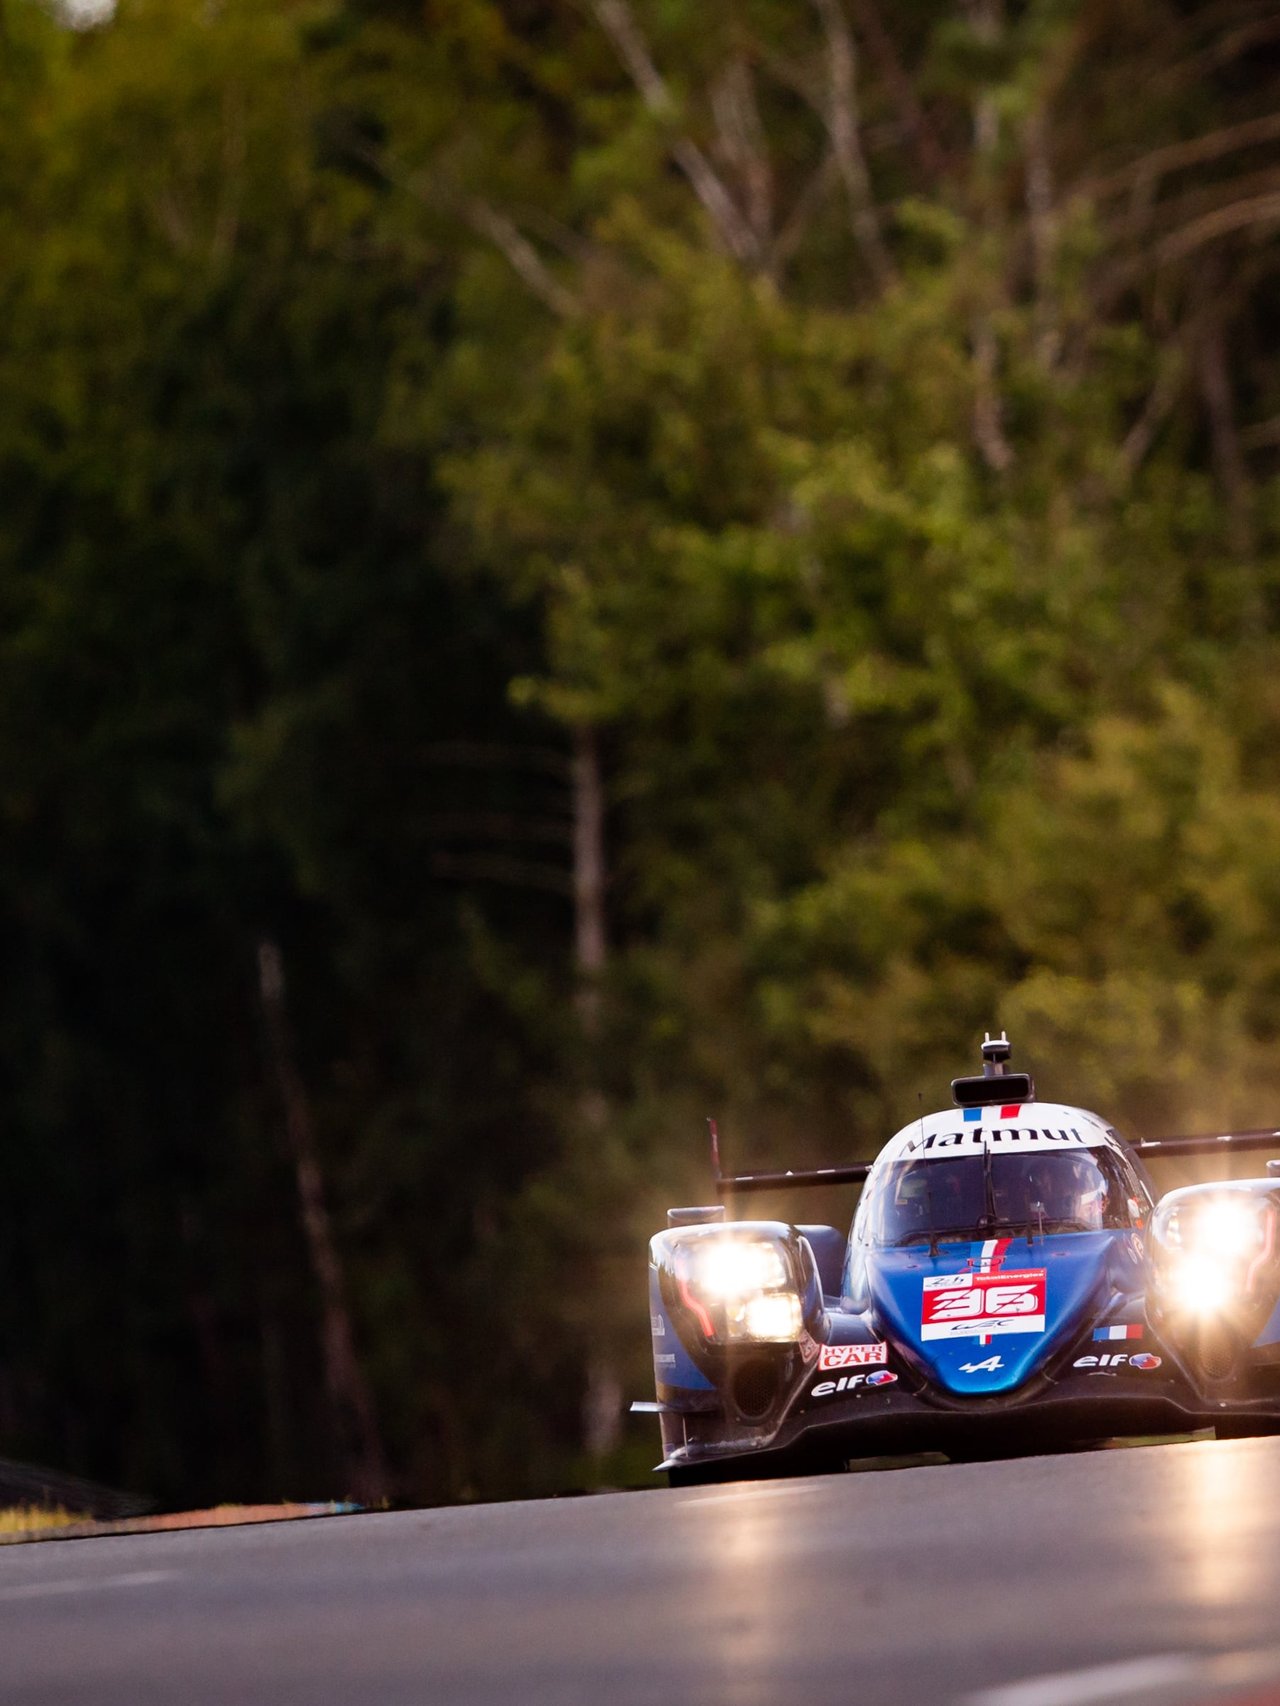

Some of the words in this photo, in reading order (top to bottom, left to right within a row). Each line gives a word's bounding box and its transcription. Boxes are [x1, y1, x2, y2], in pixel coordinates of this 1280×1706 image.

[899, 1127, 1086, 1157] Matmut
[928, 1284, 1039, 1320] 36
[823, 1352, 881, 1367] CAR
[824, 1345, 882, 1355] HYPER
[1073, 1353, 1128, 1368] elf
[810, 1373, 865, 1396] elf
